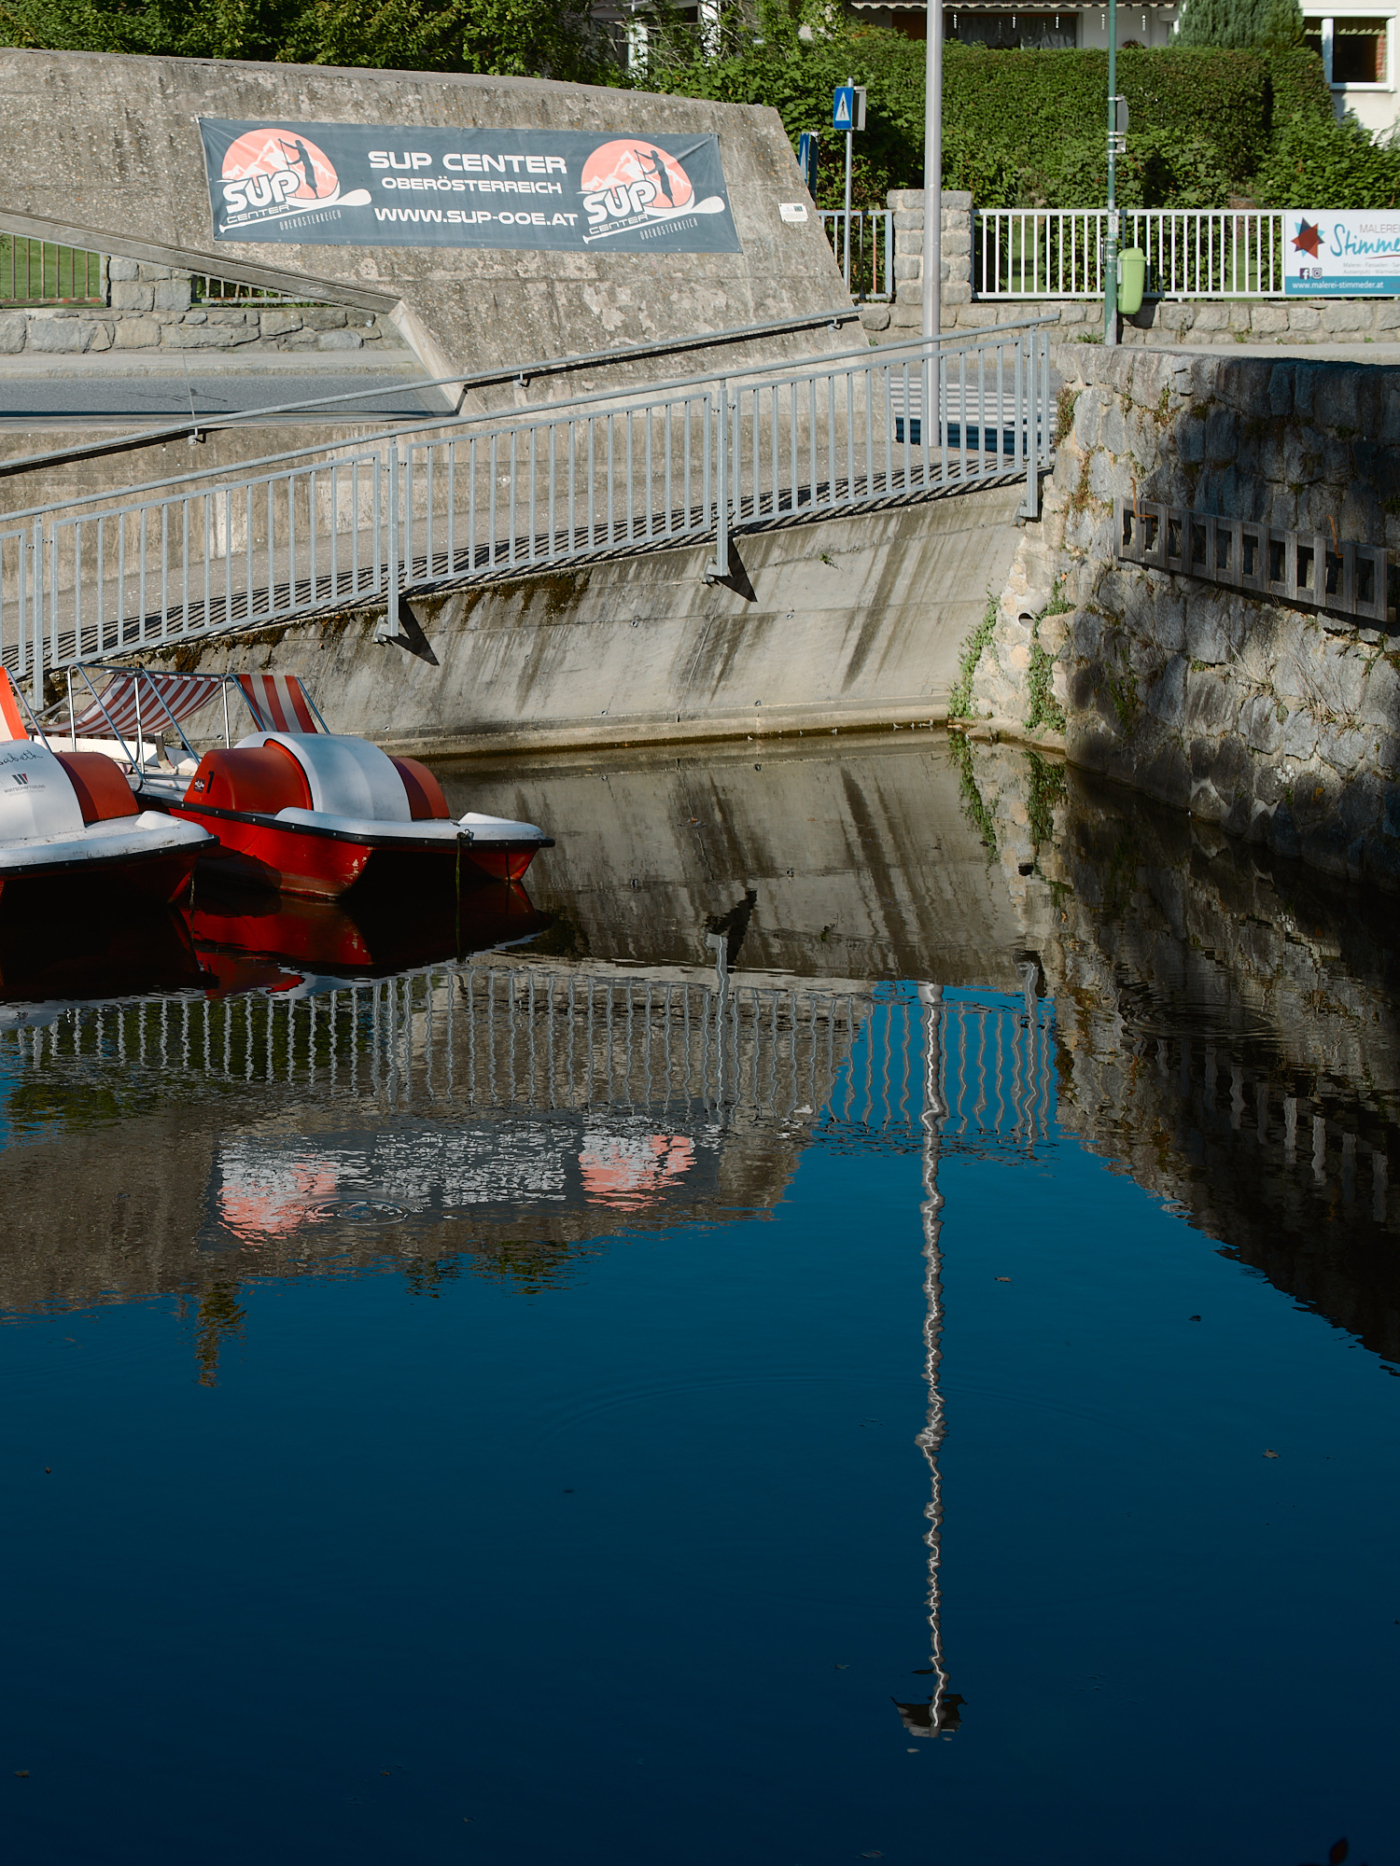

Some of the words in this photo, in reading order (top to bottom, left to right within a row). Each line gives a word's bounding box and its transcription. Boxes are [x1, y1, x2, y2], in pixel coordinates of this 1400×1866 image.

[368, 151, 432, 170] SUP
[442, 153, 568, 174] CENTER
[222, 171, 300, 213] SUP
[381, 176, 563, 194] OBERÖSTERREICH
[583, 180, 657, 224] SUP
[226, 204, 290, 224] CENTER
[374, 207, 579, 226] WWW.SUP-OOE.AT
[589, 213, 649, 235] CENTER
[206, 770, 214, 794] 1
